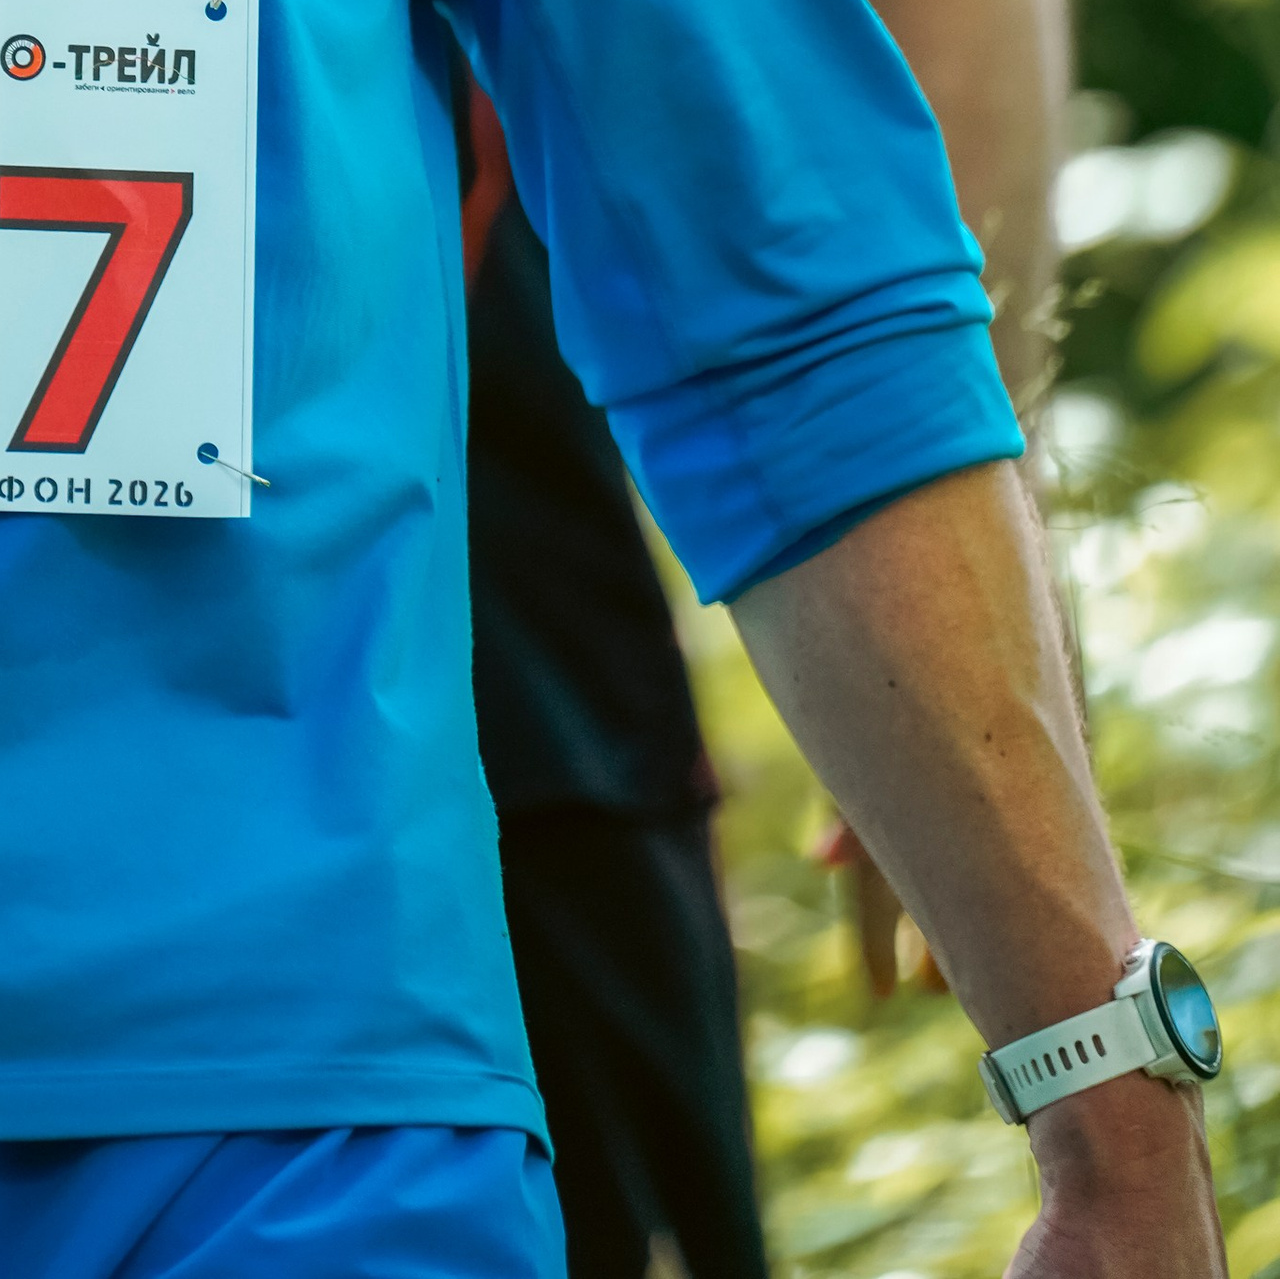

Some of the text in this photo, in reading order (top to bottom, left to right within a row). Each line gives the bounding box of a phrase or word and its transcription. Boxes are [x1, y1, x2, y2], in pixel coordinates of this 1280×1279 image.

[75, 83, 99, 91] забеги
[107, 85, 169, 95] ориентирование
[107, 478, 194, 508] 2026
